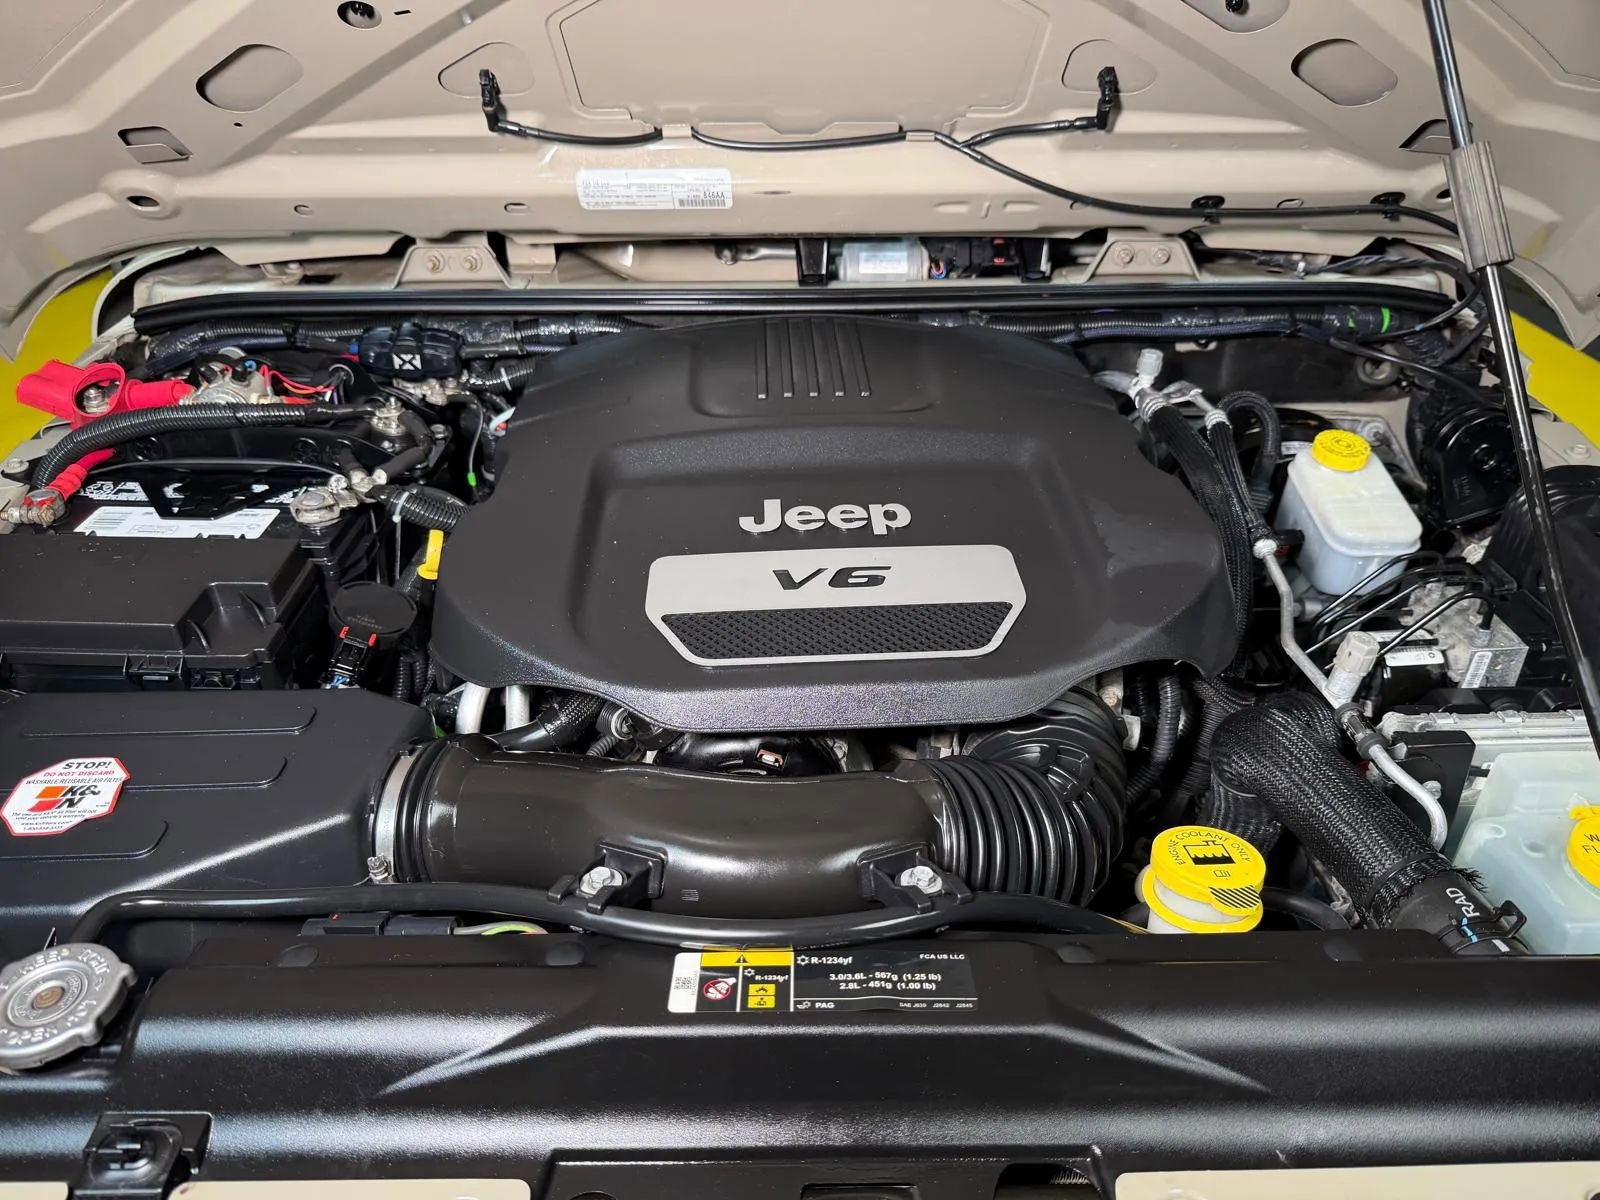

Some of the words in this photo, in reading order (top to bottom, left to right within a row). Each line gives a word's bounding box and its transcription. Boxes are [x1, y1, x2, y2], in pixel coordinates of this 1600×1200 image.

[738, 498, 912, 535] Jeep
[772, 566, 892, 590] V6
[62, 761, 112, 770] STOP!
[1176, 831, 1230, 842] COOLANT
[1584, 834, 1600, 842] W
[1168, 840, 1186, 865] ENGINE
[1231, 842, 1251, 862] ONLY
[1446, 888, 1480, 918] RAD
[811, 956, 853, 965] R-1234yf
[829, 973, 867, 981] 3.0/3.6L
[902, 973, 928, 981] (1.25
[928, 973, 942, 981] lb)
[868, 981, 893, 990] 451g
[897, 982, 921, 990] (1.00
[922, 982, 936, 990] lb)
